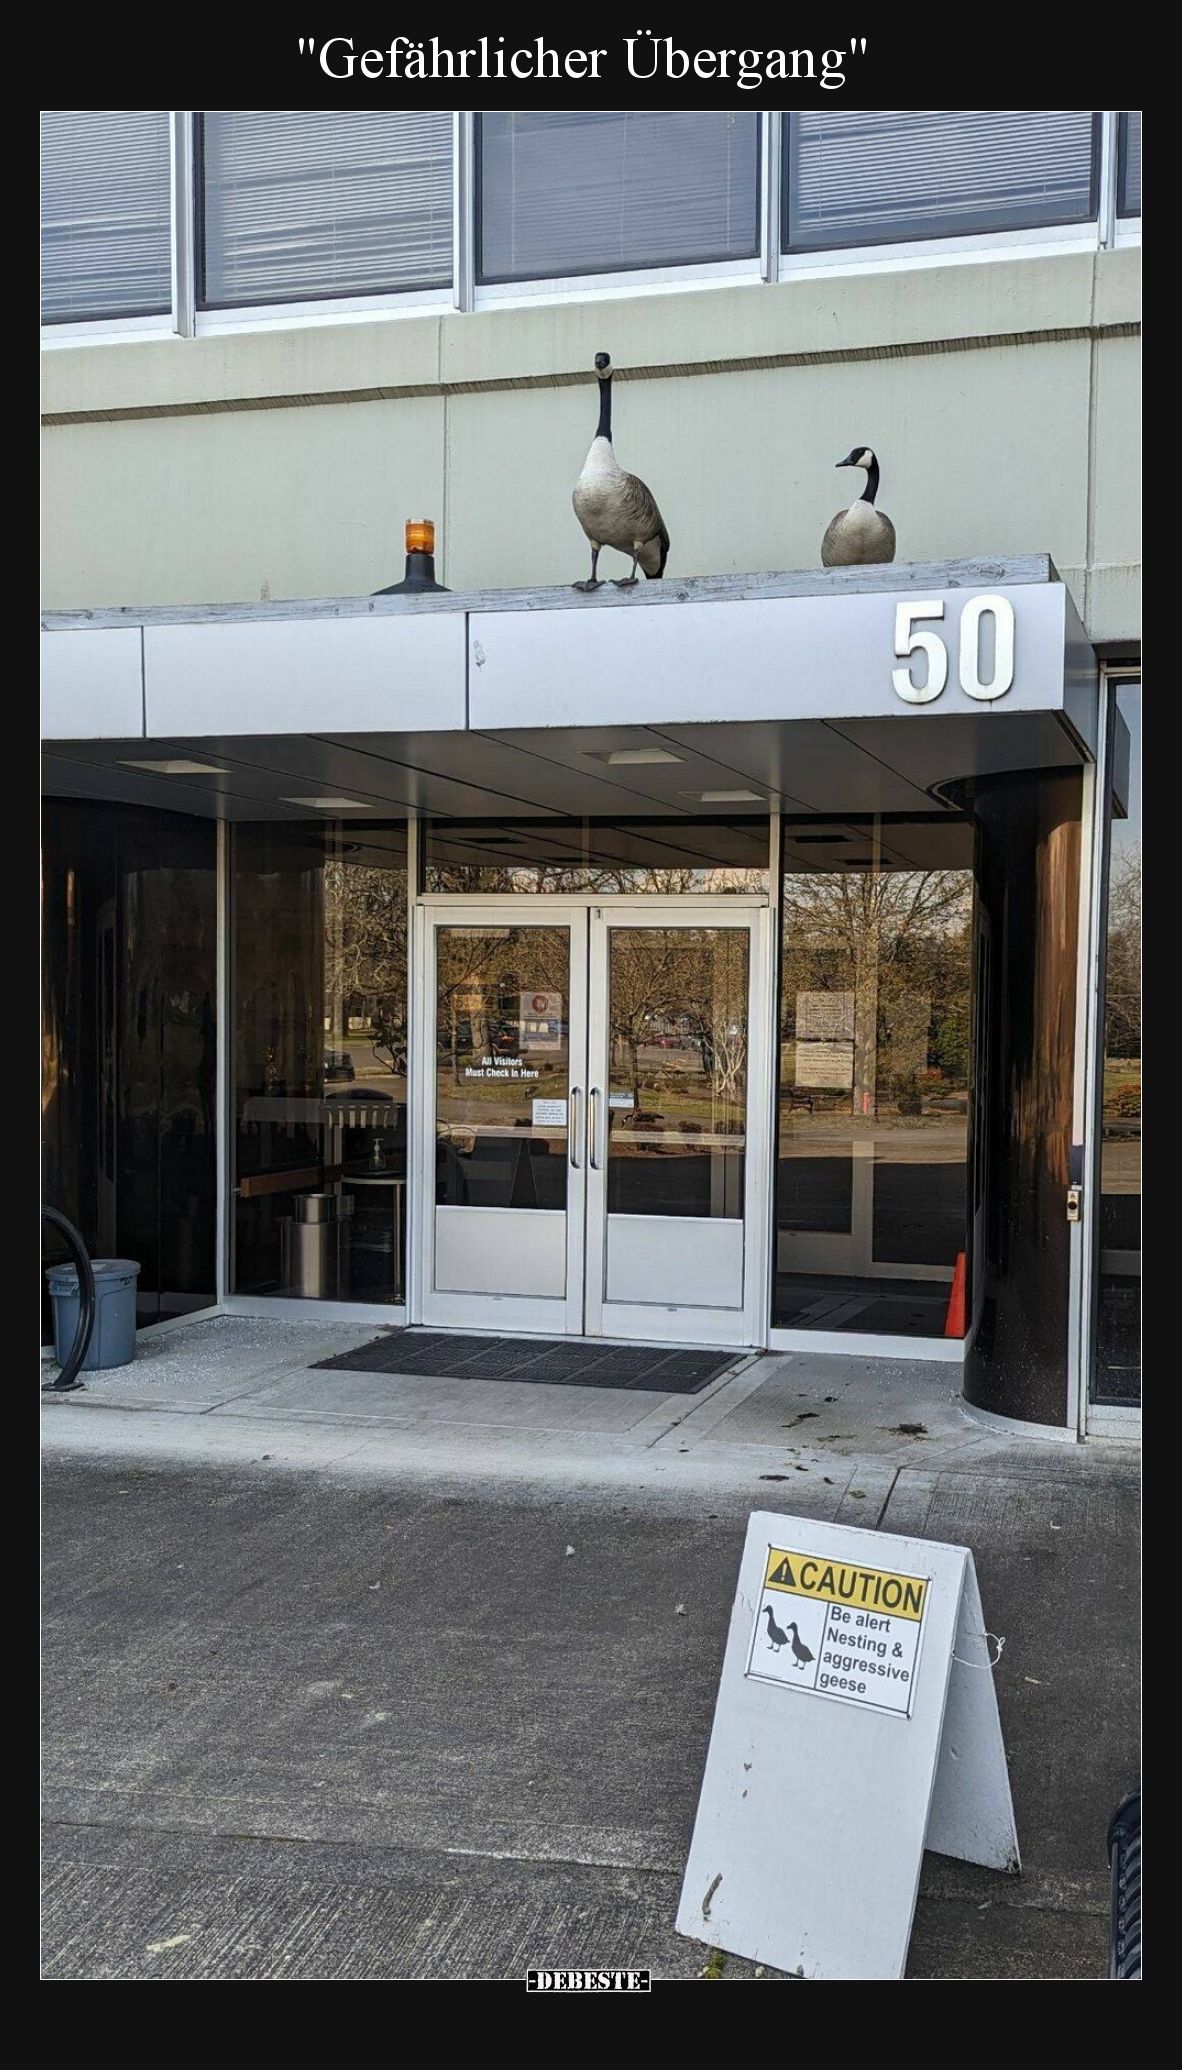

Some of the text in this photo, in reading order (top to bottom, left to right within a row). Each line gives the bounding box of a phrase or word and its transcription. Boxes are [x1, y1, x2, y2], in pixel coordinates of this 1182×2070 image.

[892, 594, 1015, 705] 50
[465, 1067, 539, 1078] Must Check In Here
[481, 1056, 523, 1066] All Visitors
[800, 1561, 923, 1613] CAUTION
[831, 1606, 892, 1633] Be alert
[827, 1627, 903, 1658] Nesting &
[823, 1651, 910, 1682] aggressive
[820, 1673, 867, 1694] geese
